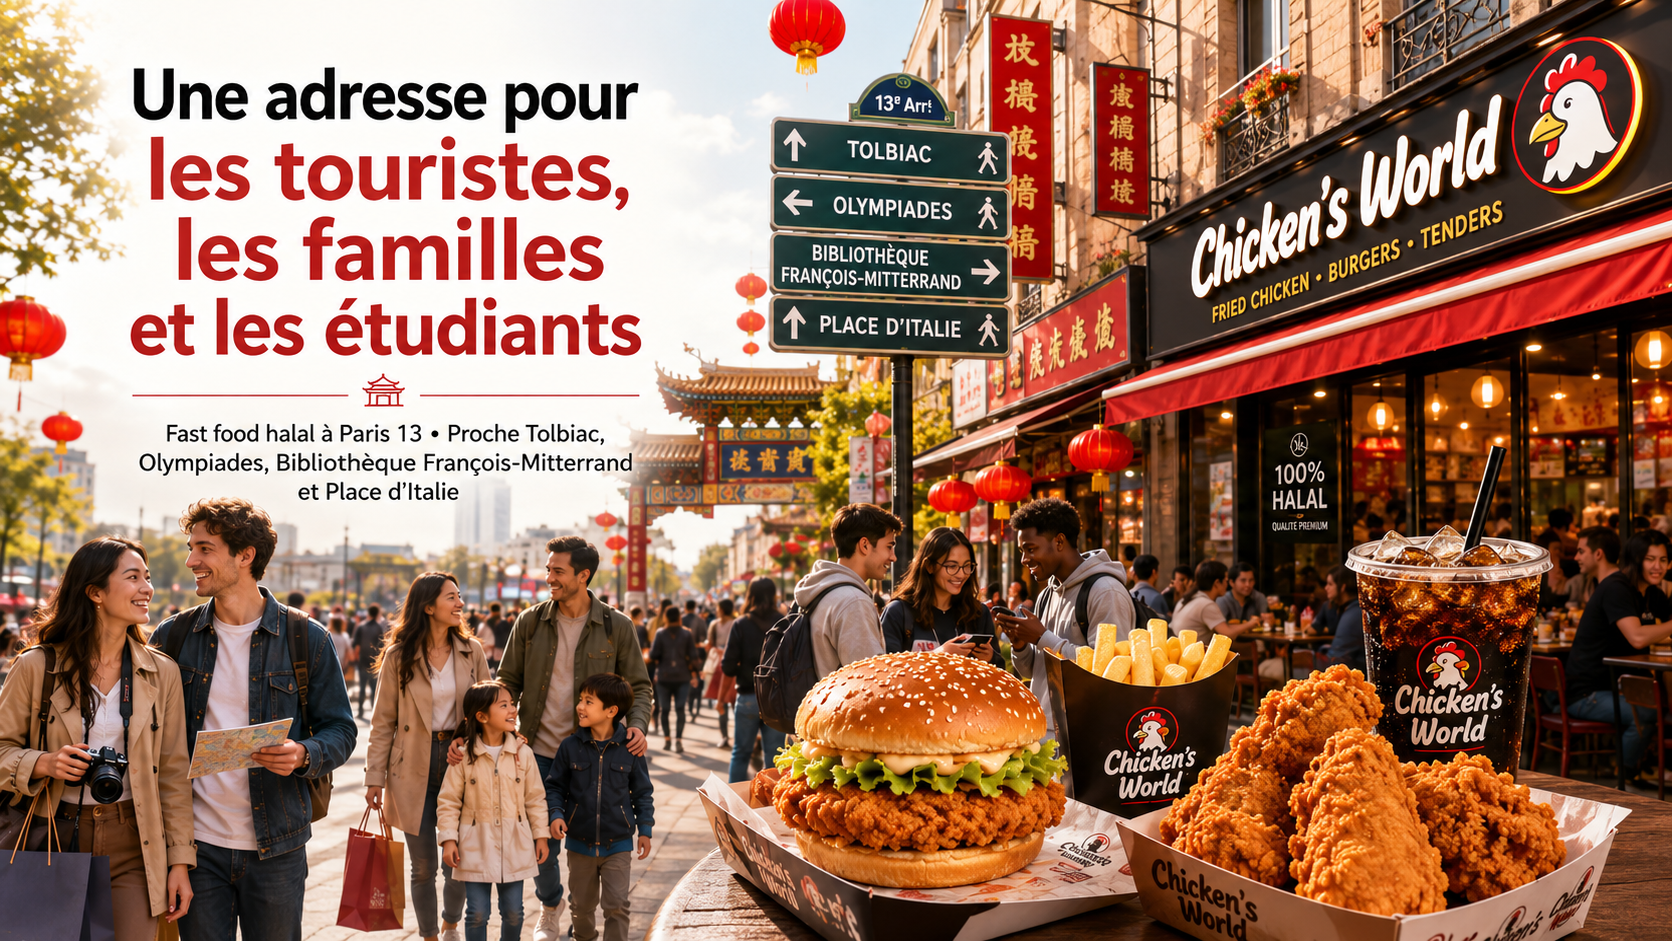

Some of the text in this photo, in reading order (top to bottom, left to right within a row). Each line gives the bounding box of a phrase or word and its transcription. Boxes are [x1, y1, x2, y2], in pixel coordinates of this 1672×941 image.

[846, 139, 932, 164] TOLBIAC
[833, 195, 953, 221] OLYMPIADES
[1191, 94, 1502, 298] Chicken's World
[811, 243, 930, 269] BIBLIOTHÈQUE
[1212, 200, 1504, 323] FRIED CHICKEN BURGERS TENDERS
[780, 265, 962, 291] FRANÇOIS-MITTERRAND
[820, 314, 879, 335] PLACE
[1275, 460, 1325, 485] 100%
[1272, 487, 1328, 511] HALAL
[1394, 683, 1504, 715] Chicken's
[1411, 714, 1489, 746] World
[1103, 746, 1197, 776] Chicken's
[1118, 771, 1184, 799] World
[1151, 858, 1259, 923] Chicken's
[1177, 895, 1248, 941] World
